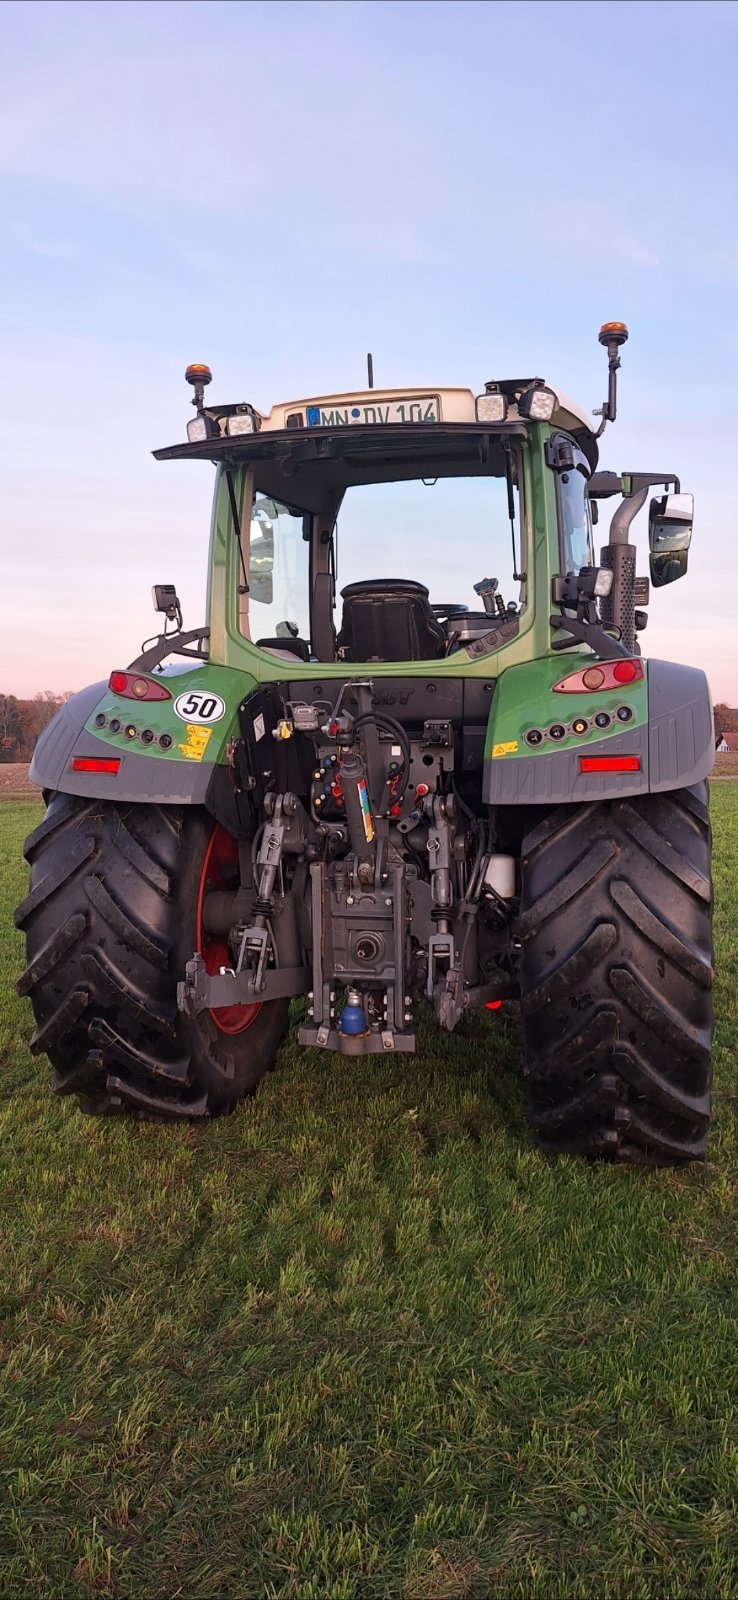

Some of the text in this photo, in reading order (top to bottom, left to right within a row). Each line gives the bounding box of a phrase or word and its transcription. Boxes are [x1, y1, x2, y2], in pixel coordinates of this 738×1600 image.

[321, 410, 349, 426] MN
[396, 402, 437, 423] 104
[182, 694, 217, 718] 50
